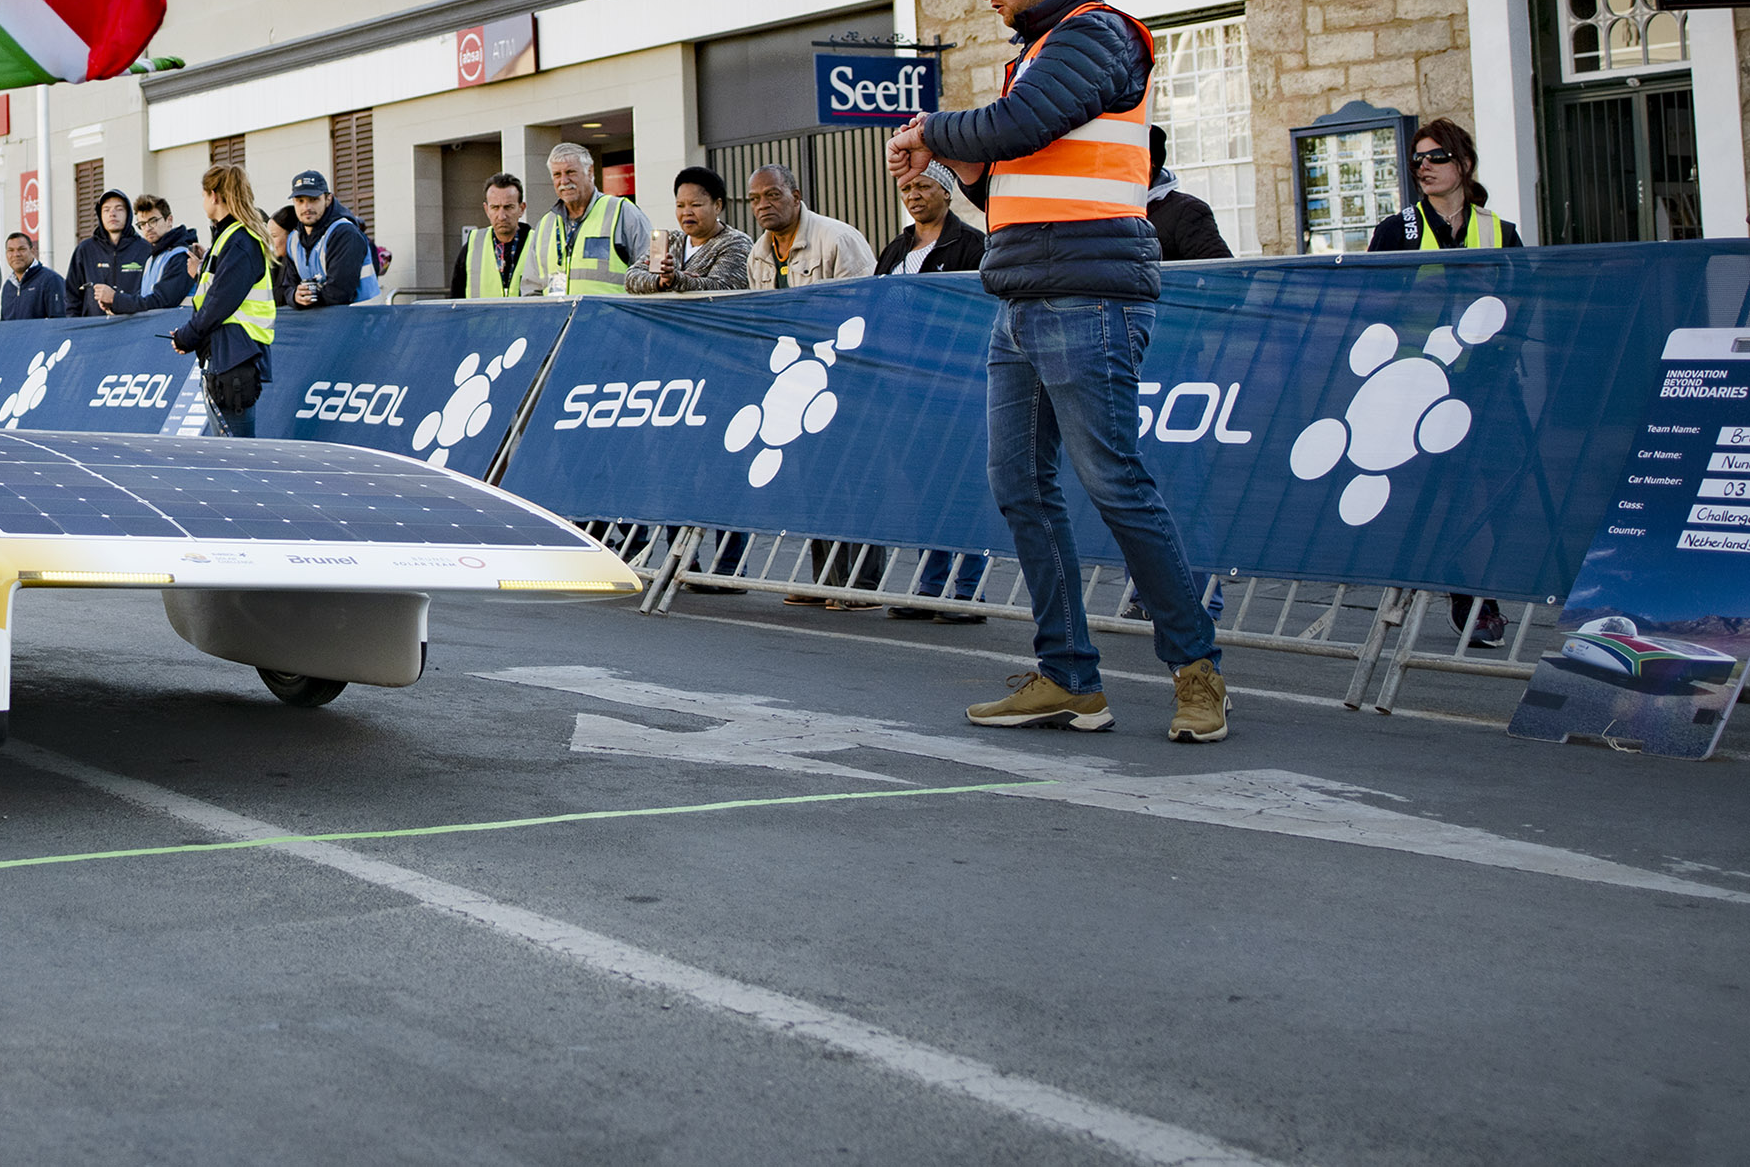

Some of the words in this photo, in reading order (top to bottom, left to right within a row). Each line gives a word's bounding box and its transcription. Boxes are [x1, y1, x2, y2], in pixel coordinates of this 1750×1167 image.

[492, 38, 516, 61] ATM
[830, 65, 926, 112] Seeff
[1404, 221, 1419, 240] SEA
[1666, 370, 1728, 379] INNOVATION
[1663, 378, 1703, 386] BEYOND
[1659, 386, 1748, 398] BOUNDARIES
[1647, 425, 1670, 433] Team
[1671, 425, 1701, 434] Name:
[1730, 428, 1750, 444] Br
[1638, 450, 1652, 458] Car
[1653, 450, 1682, 459] Name:
[1721, 455, 1750, 470] Nun
[1628, 475, 1642, 483] Car
[1643, 476, 1683, 485] Number:
[1723, 481, 1747, 497] 03
[1618, 500, 1645, 509] Class:
[1696, 507, 1750, 525] Challeng
[1608, 526, 1646, 536] Country:
[286, 554, 359, 566] Brunel
